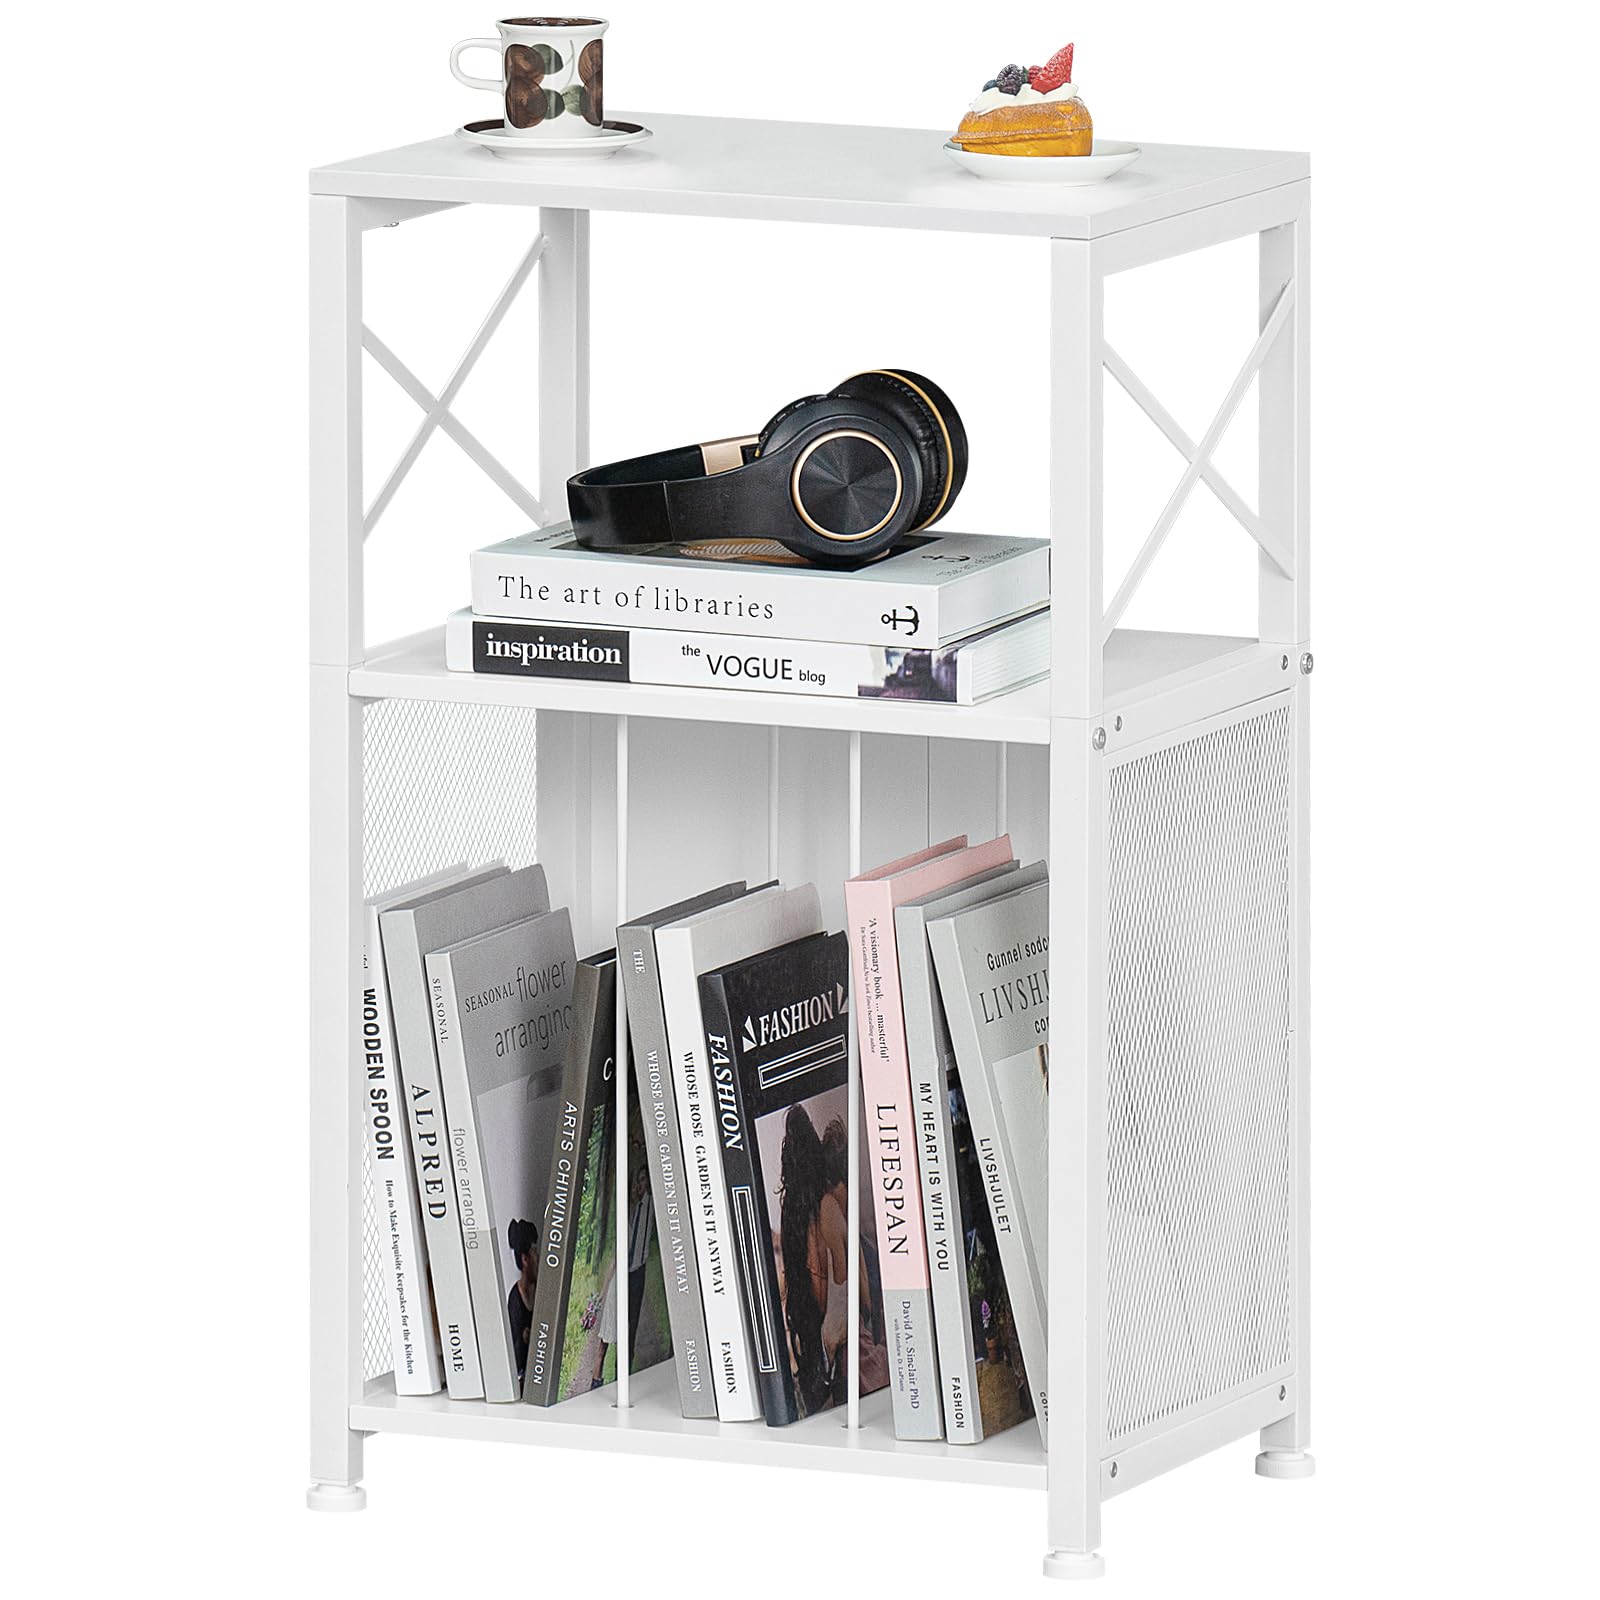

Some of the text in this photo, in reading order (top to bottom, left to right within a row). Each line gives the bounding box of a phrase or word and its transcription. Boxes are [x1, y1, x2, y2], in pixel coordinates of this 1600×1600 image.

[498, 575, 773, 619] The art of libraries
[485, 632, 622, 666] inspiration
[681, 643, 826, 686] the VOGUE blog
[633, 949, 646, 974] THE
[869, 929, 880, 973] visionary
[986, 943, 1022, 971] Gunnel
[432, 978, 449, 1044] SEASONAL
[465, 961, 566, 1013] SEASONAL flower
[873, 976, 884, 1000] book
[758, 990, 834, 1047] FASHION
[363, 988, 395, 1160] WOODEN SPOON
[708, 1033, 743, 1151] FASHION
[411, 1084, 447, 1220] ALPRED
[646, 1050, 690, 1294] WHOSE ROSE GARDEN IS IT ANYWAY
[683, 1051, 726, 1295] WHOSE ROSE GARDEN IS IT ANYWAY
[919, 1082, 949, 1270] MY HEART IS WITH YOU
[385, 1179, 393, 1197] How
[387, 1197, 395, 1207] to
[453, 1128, 479, 1250] flower arranging
[546, 1100, 578, 1268] ARTS CHIWINGLO
[876, 1103, 909, 1256] LIFESPAN
[979, 1137, 1012, 1234] LIVSHJULET
[387, 1208, 397, 1230] Make
[391, 1233, 402, 1270] Exquisite
[396, 1272, 407, 1314] Keepsakes
[902, 1300, 914, 1329] David
[400, 1315, 408, 1327] for
[404, 1343, 414, 1375] Kitchen
[448, 1324, 464, 1372] HOME
[533, 1322, 549, 1385] FASHION
[685, 1339, 702, 1392] FASHION
[721, 1341, 738, 1394] FASHION
[906, 1347, 919, 1386] Sinclair
[910, 1388, 920, 1409] PhD
[951, 1376, 965, 1429] FASHION
